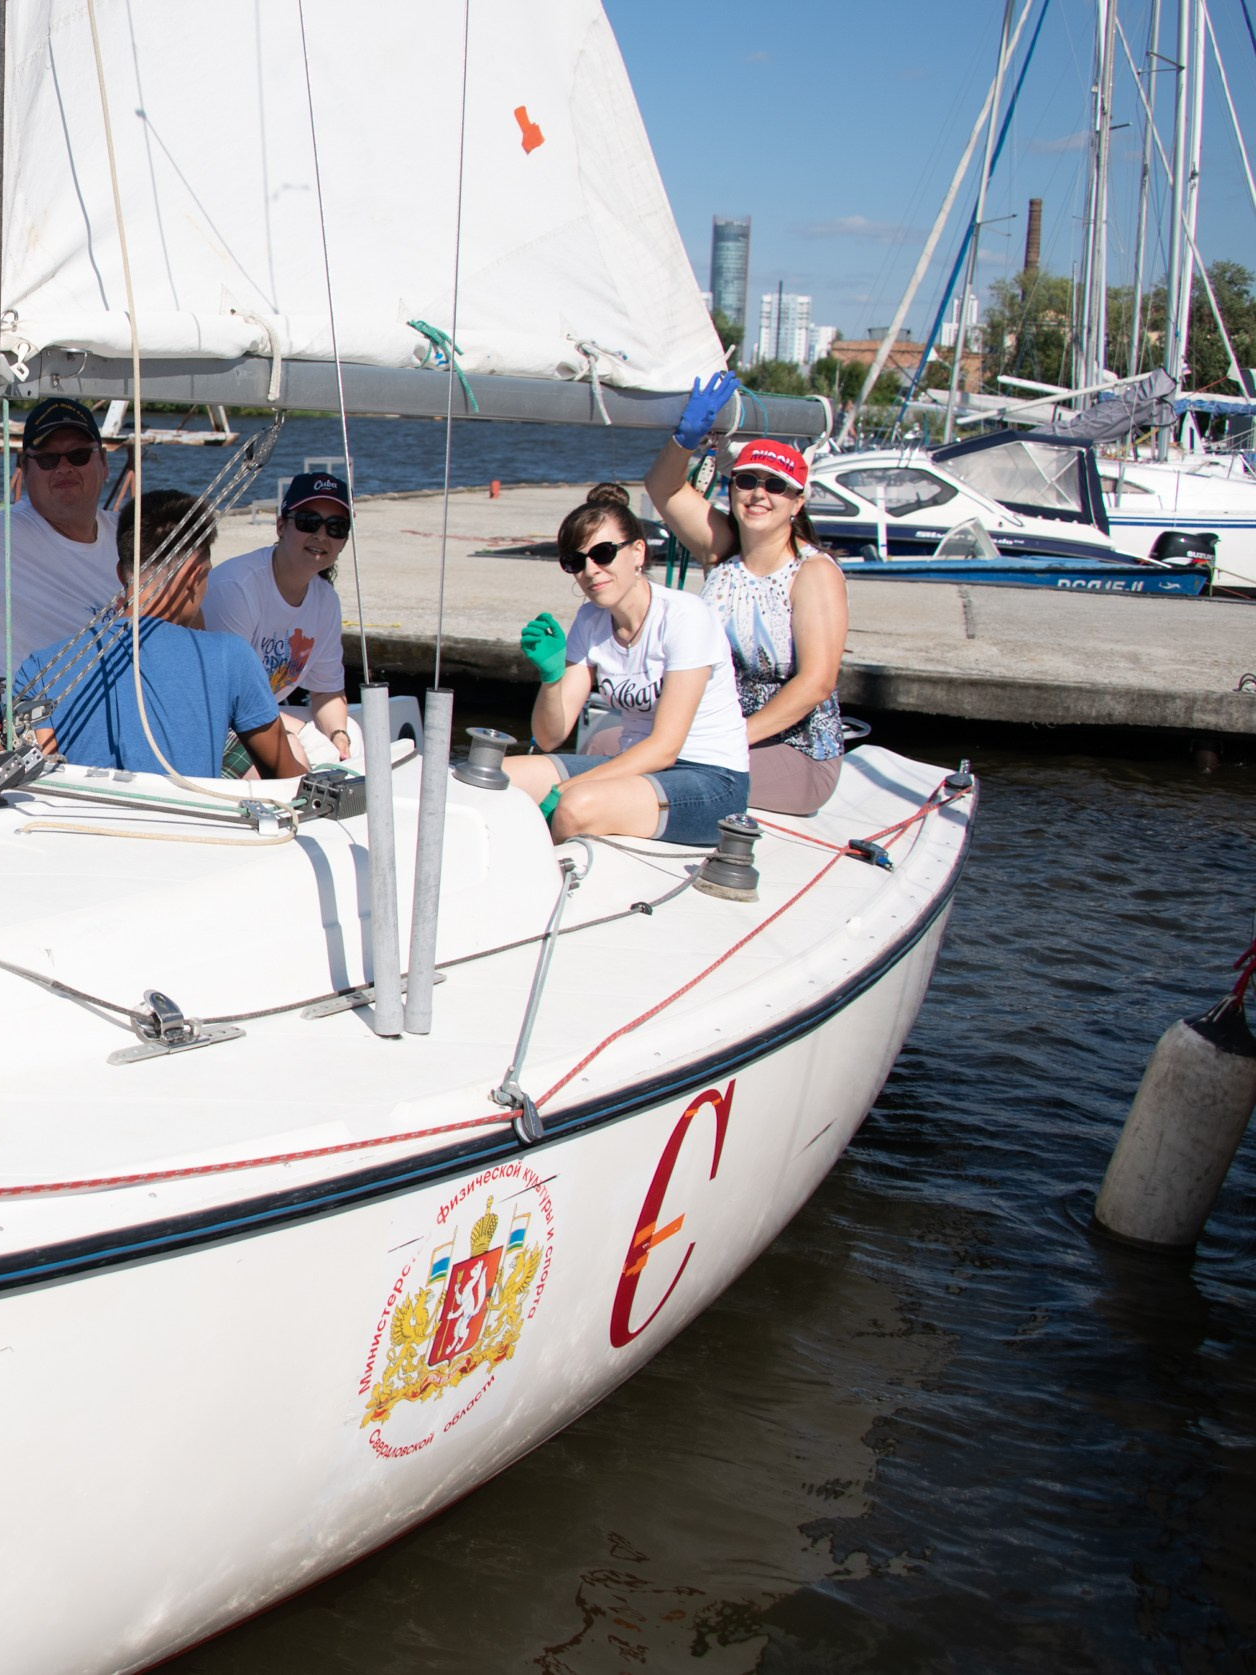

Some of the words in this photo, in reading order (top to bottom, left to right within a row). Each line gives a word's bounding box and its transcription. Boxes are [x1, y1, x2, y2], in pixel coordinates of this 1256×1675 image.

[313, 480, 337, 490] Cuba
[436, 1160, 522, 1225] физической
[523, 1168, 555, 1225] культуры
[546, 1226, 555, 1241] и
[527, 1245, 554, 1319] спорта
[368, 1428, 434, 1459] Свердловской
[443, 1375, 495, 1433] области
